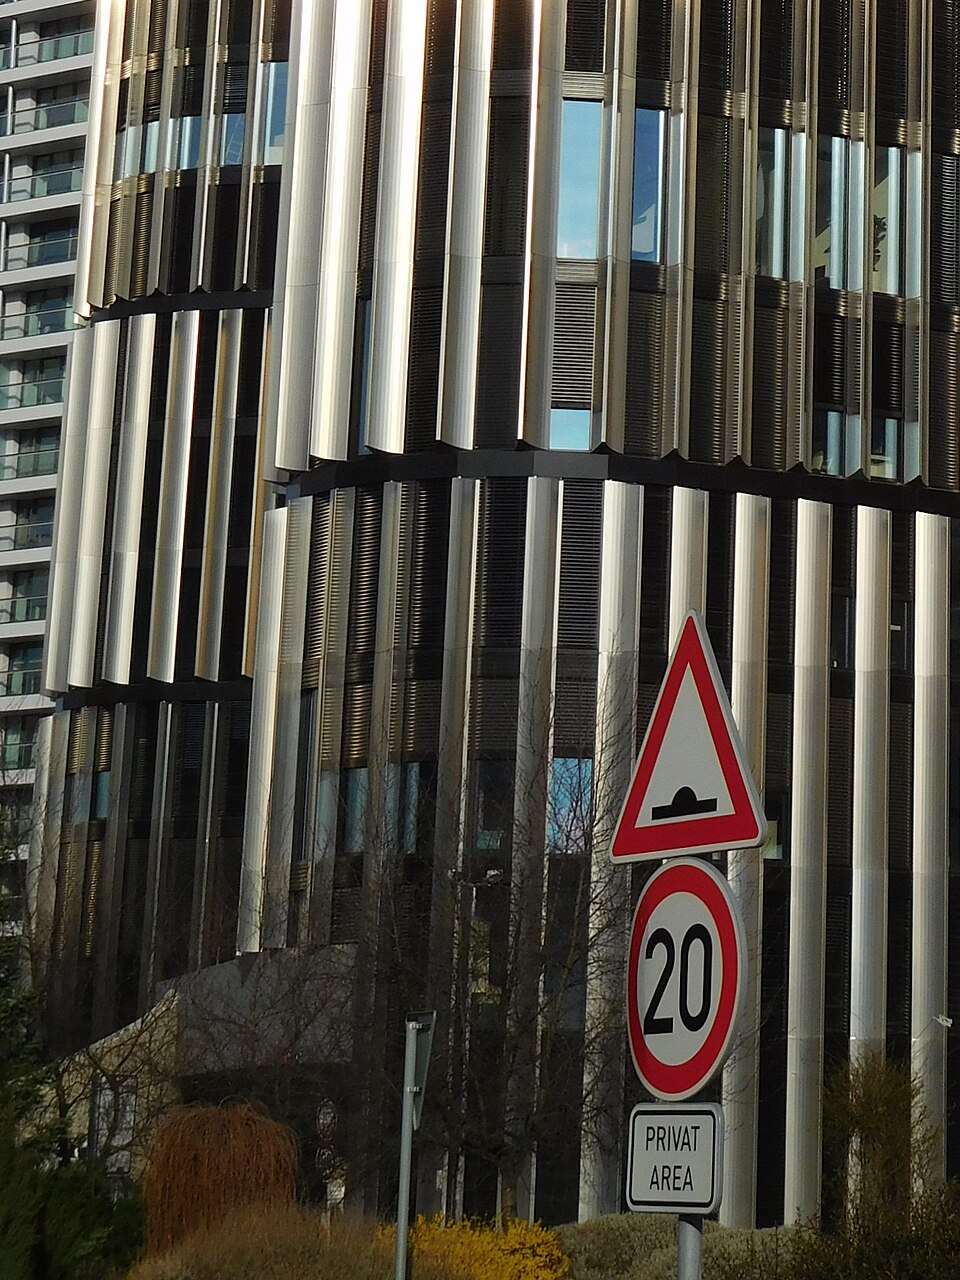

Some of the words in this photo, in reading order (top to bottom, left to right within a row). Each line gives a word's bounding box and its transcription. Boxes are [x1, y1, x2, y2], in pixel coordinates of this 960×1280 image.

[643, 923, 713, 1036] 20
[645, 1125, 701, 1153] PRIVAT
[649, 1164, 694, 1192] AREA
